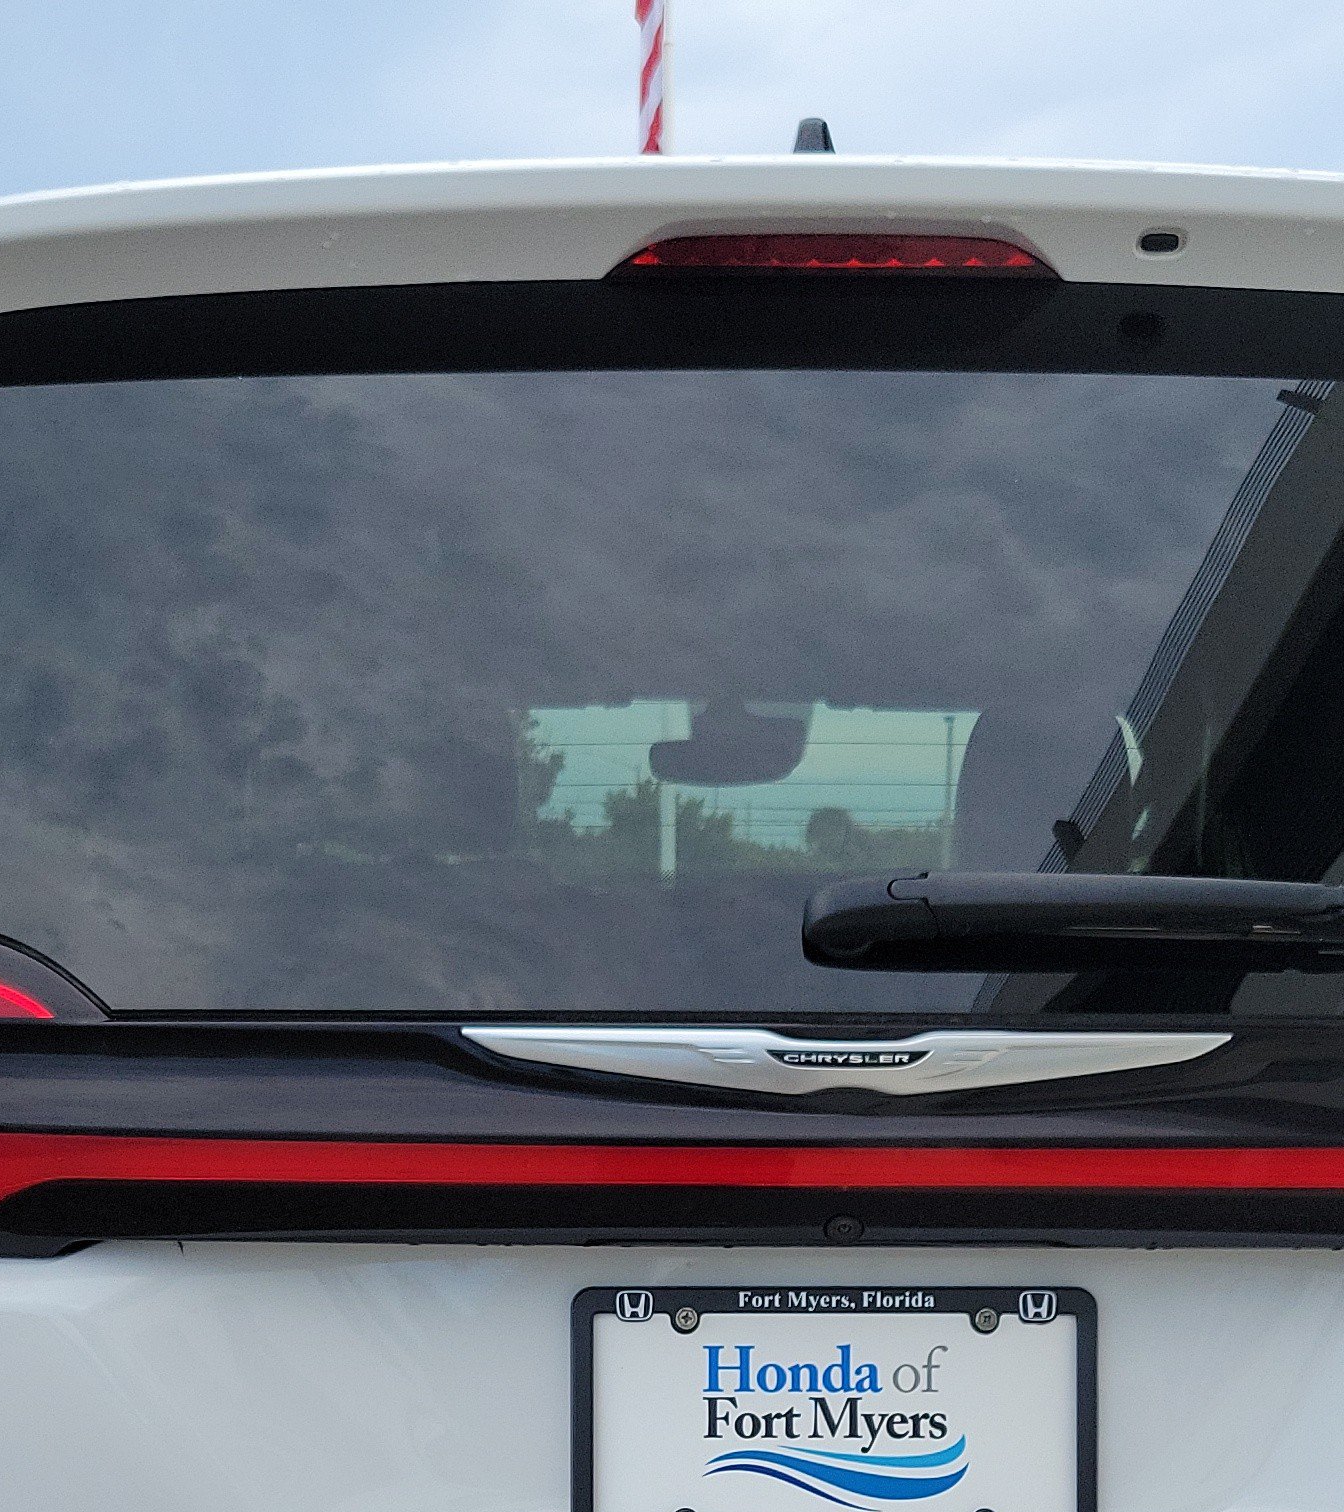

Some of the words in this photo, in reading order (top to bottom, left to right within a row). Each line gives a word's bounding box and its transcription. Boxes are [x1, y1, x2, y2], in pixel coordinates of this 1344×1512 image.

[783, 1053, 910, 1064] CHRYSLER
[738, 1291, 781, 1308] Fort
[788, 1291, 856, 1311] Myers,
[862, 1291, 935, 1308] Florida
[702, 1343, 883, 1393] Honda
[892, 1345, 948, 1394] of
[702, 1396, 801, 1439] Fort
[808, 1396, 948, 1454] Myers
